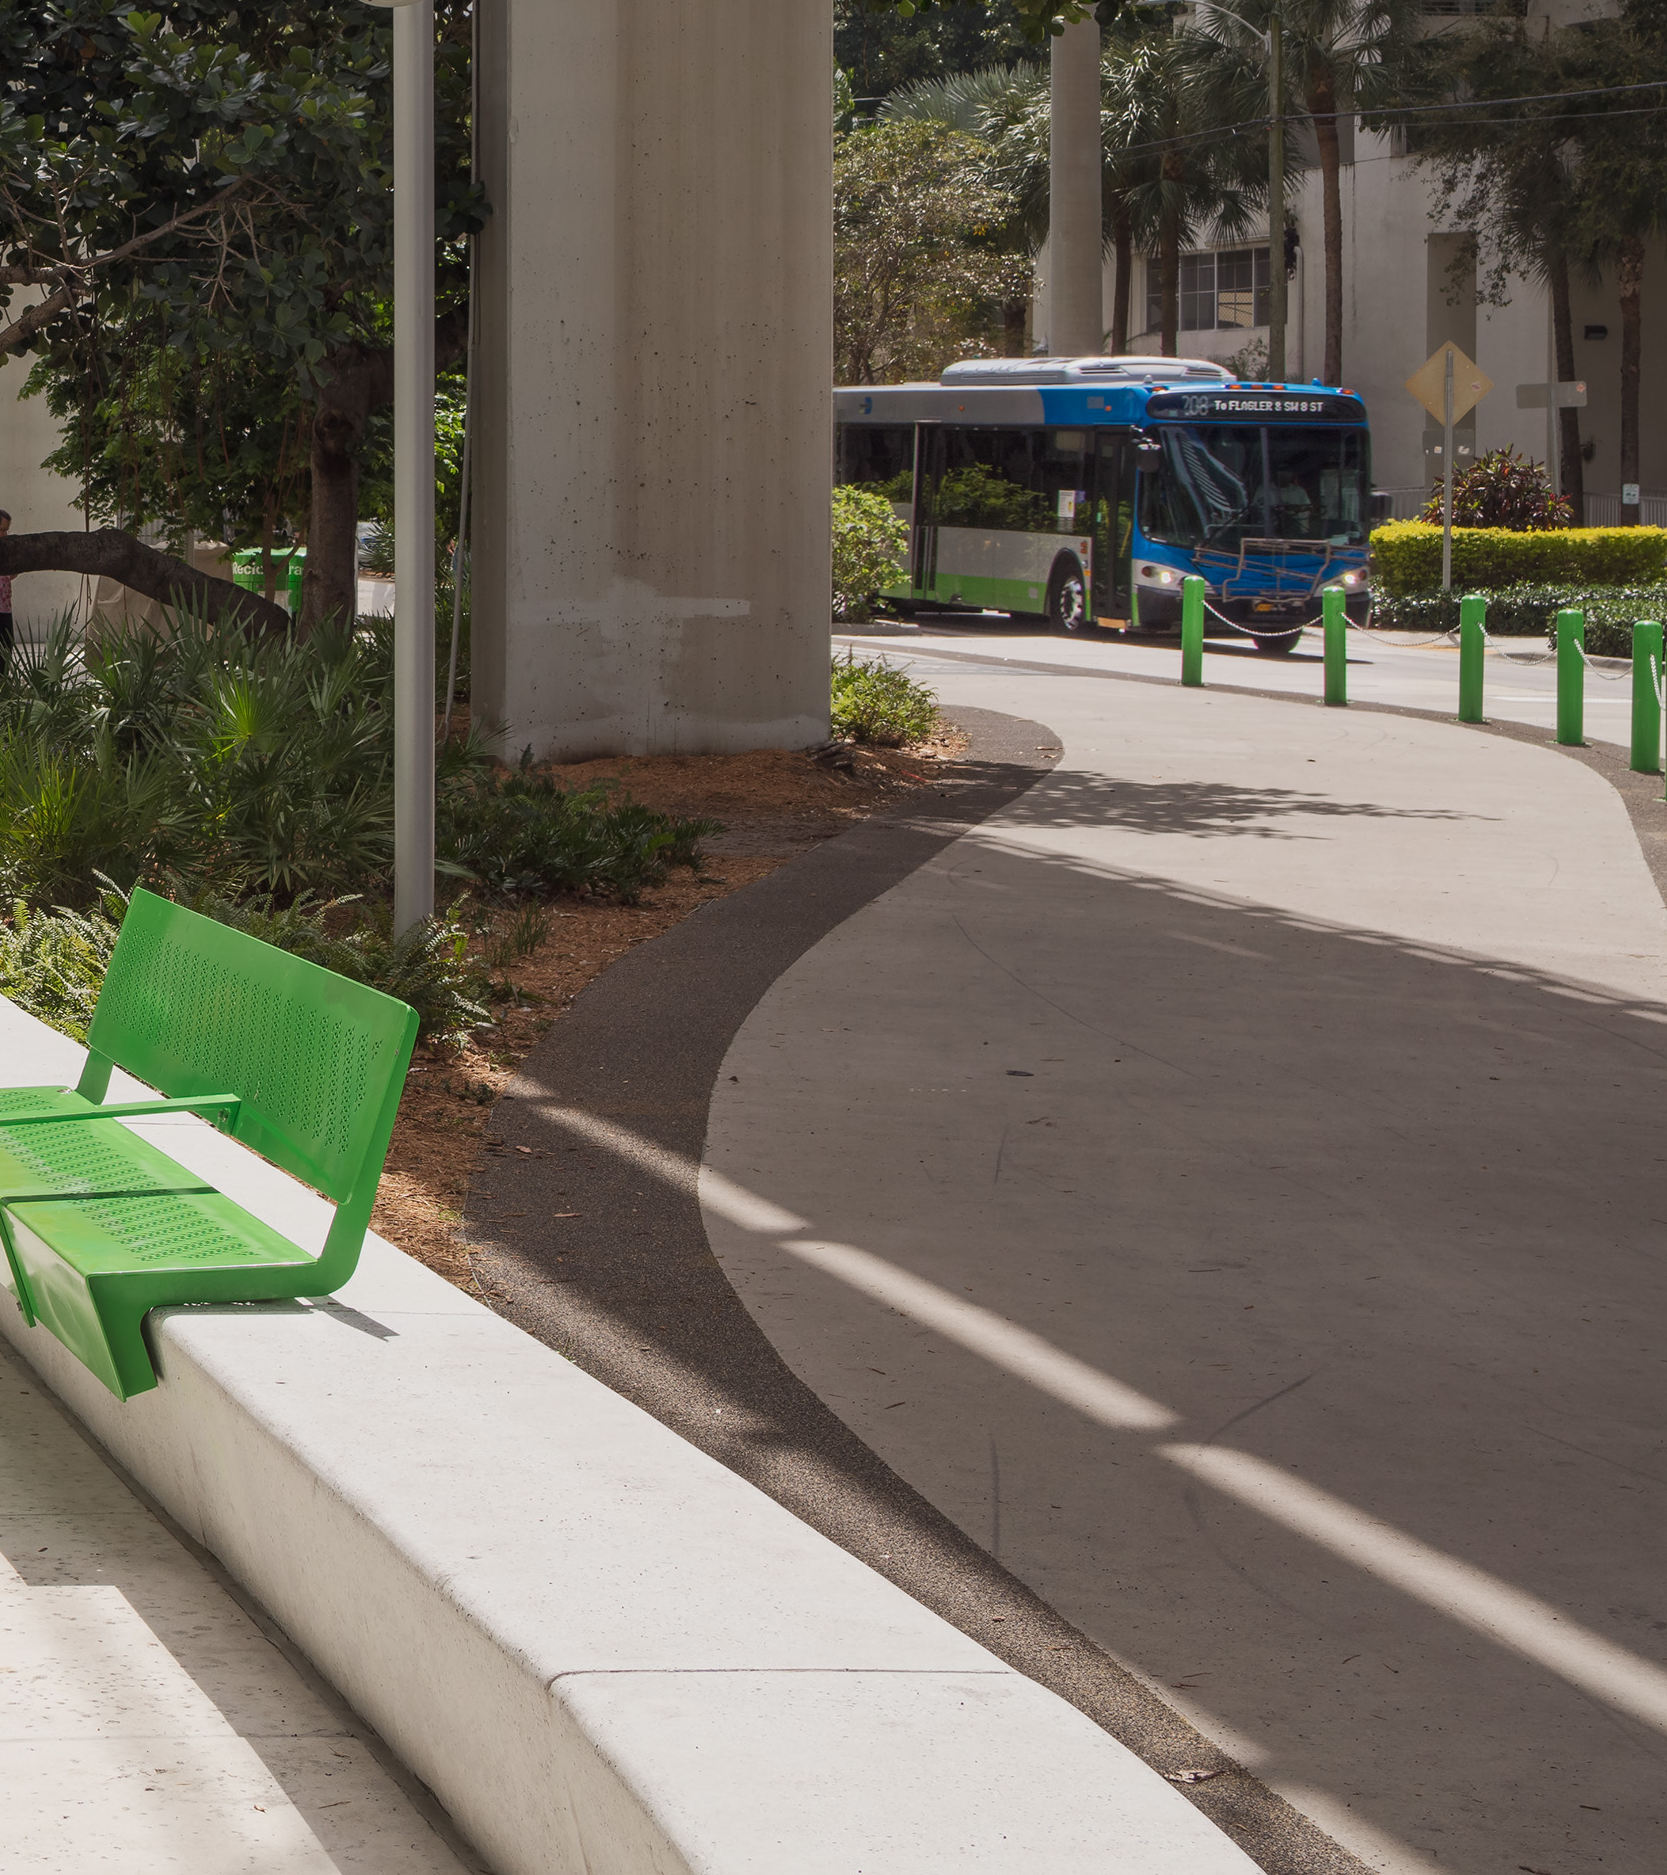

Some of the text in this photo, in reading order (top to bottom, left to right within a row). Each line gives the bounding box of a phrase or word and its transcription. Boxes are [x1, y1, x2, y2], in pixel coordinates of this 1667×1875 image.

[1214, 400, 1227, 411] To
[1228, 400, 1273, 412] FLAGLER
[1284, 401, 1299, 412] SW
[1300, 402, 1308, 412] 8
[1310, 402, 1324, 412] ST
